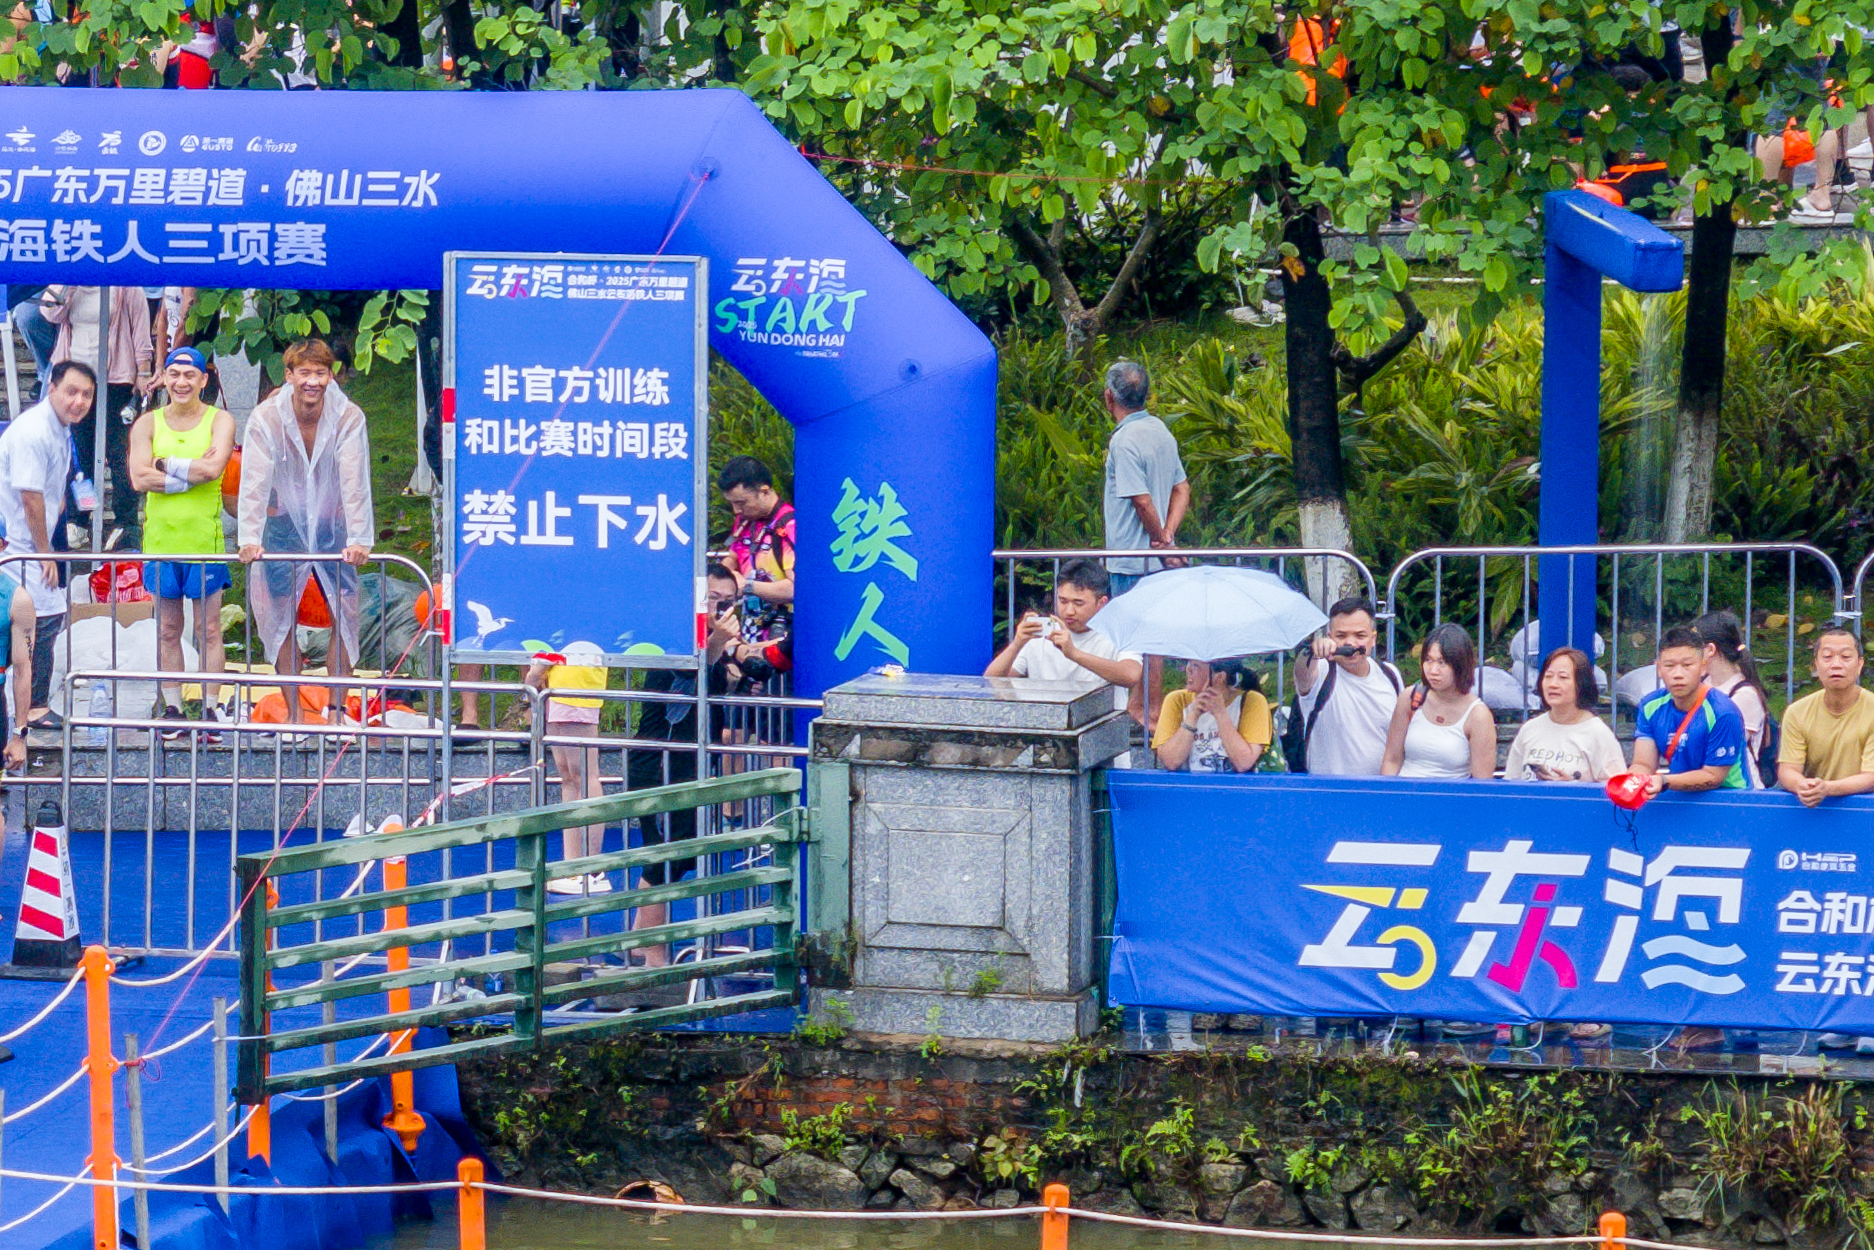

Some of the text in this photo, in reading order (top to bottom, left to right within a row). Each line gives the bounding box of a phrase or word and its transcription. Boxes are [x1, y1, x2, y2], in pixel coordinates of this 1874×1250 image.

[466, 264, 565, 299] 云东海
[730, 257, 847, 296] 云东海
[714, 290, 868, 334] START
[739, 330, 846, 347] YUN DONG HAI
[484, 365, 670, 405] 非官方训练
[464, 418, 688, 460] 和比赛时间段
[462, 489, 690, 550] 禁止下水
[829, 477, 919, 667] 铁人
[1299, 840, 1752, 995] 云东海
[1777, 890, 1874, 935] 合和
